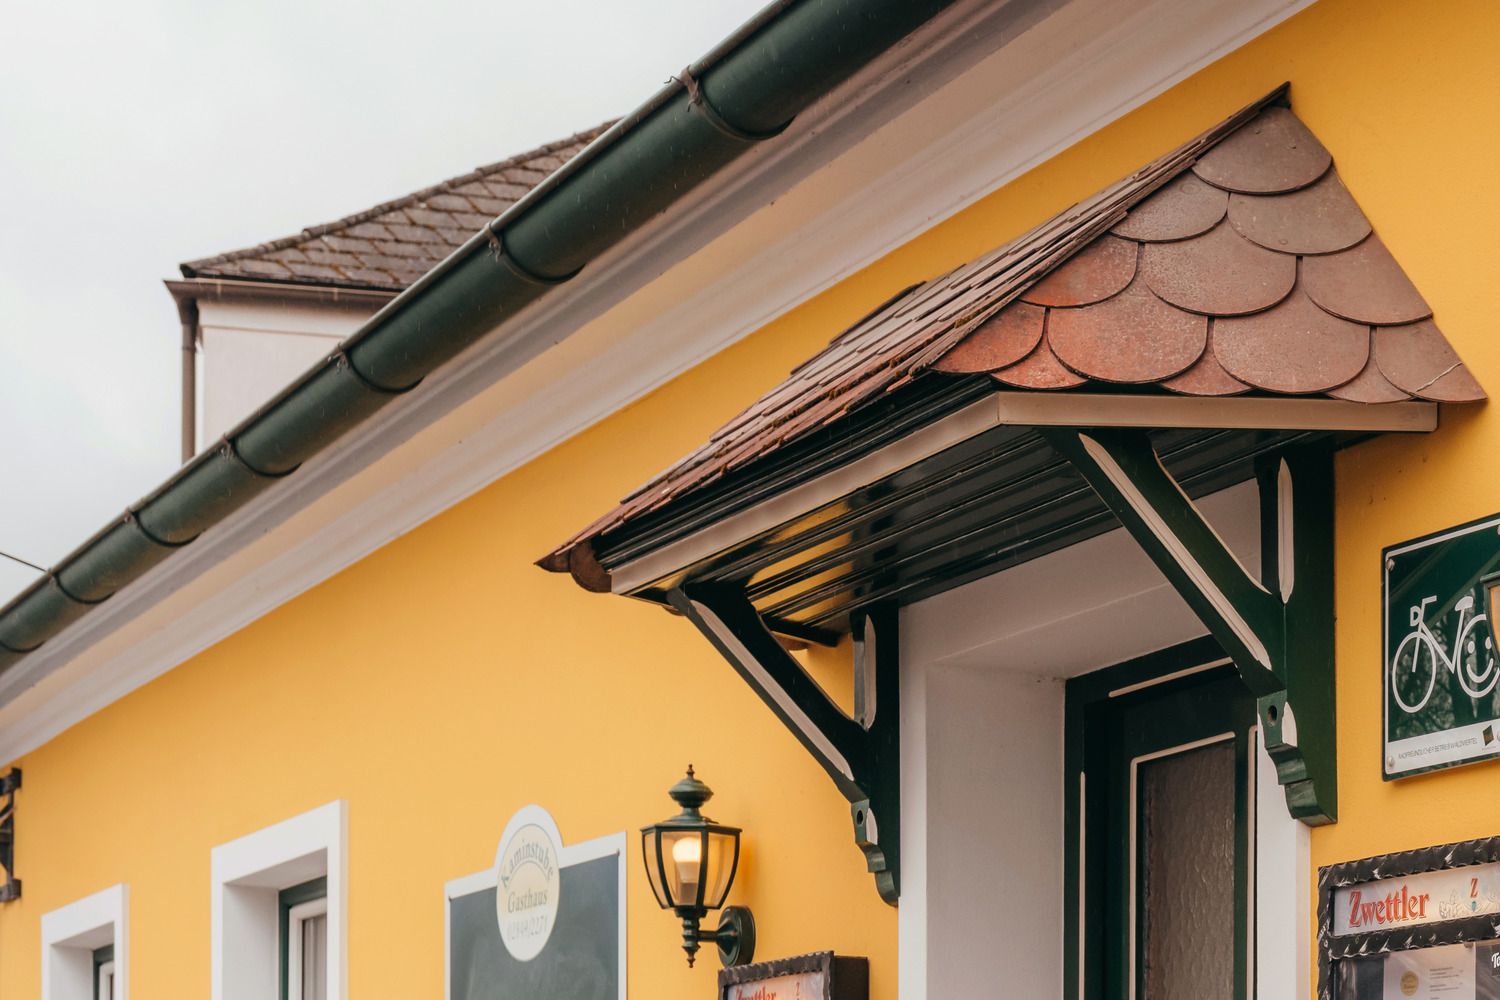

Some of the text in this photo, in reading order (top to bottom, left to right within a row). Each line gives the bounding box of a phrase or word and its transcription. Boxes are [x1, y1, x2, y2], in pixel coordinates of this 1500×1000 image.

[507, 888, 548, 914] Gasthaus
[1470, 878, 1478, 898] Z
[1349, 884, 1430, 928] Zwettler
